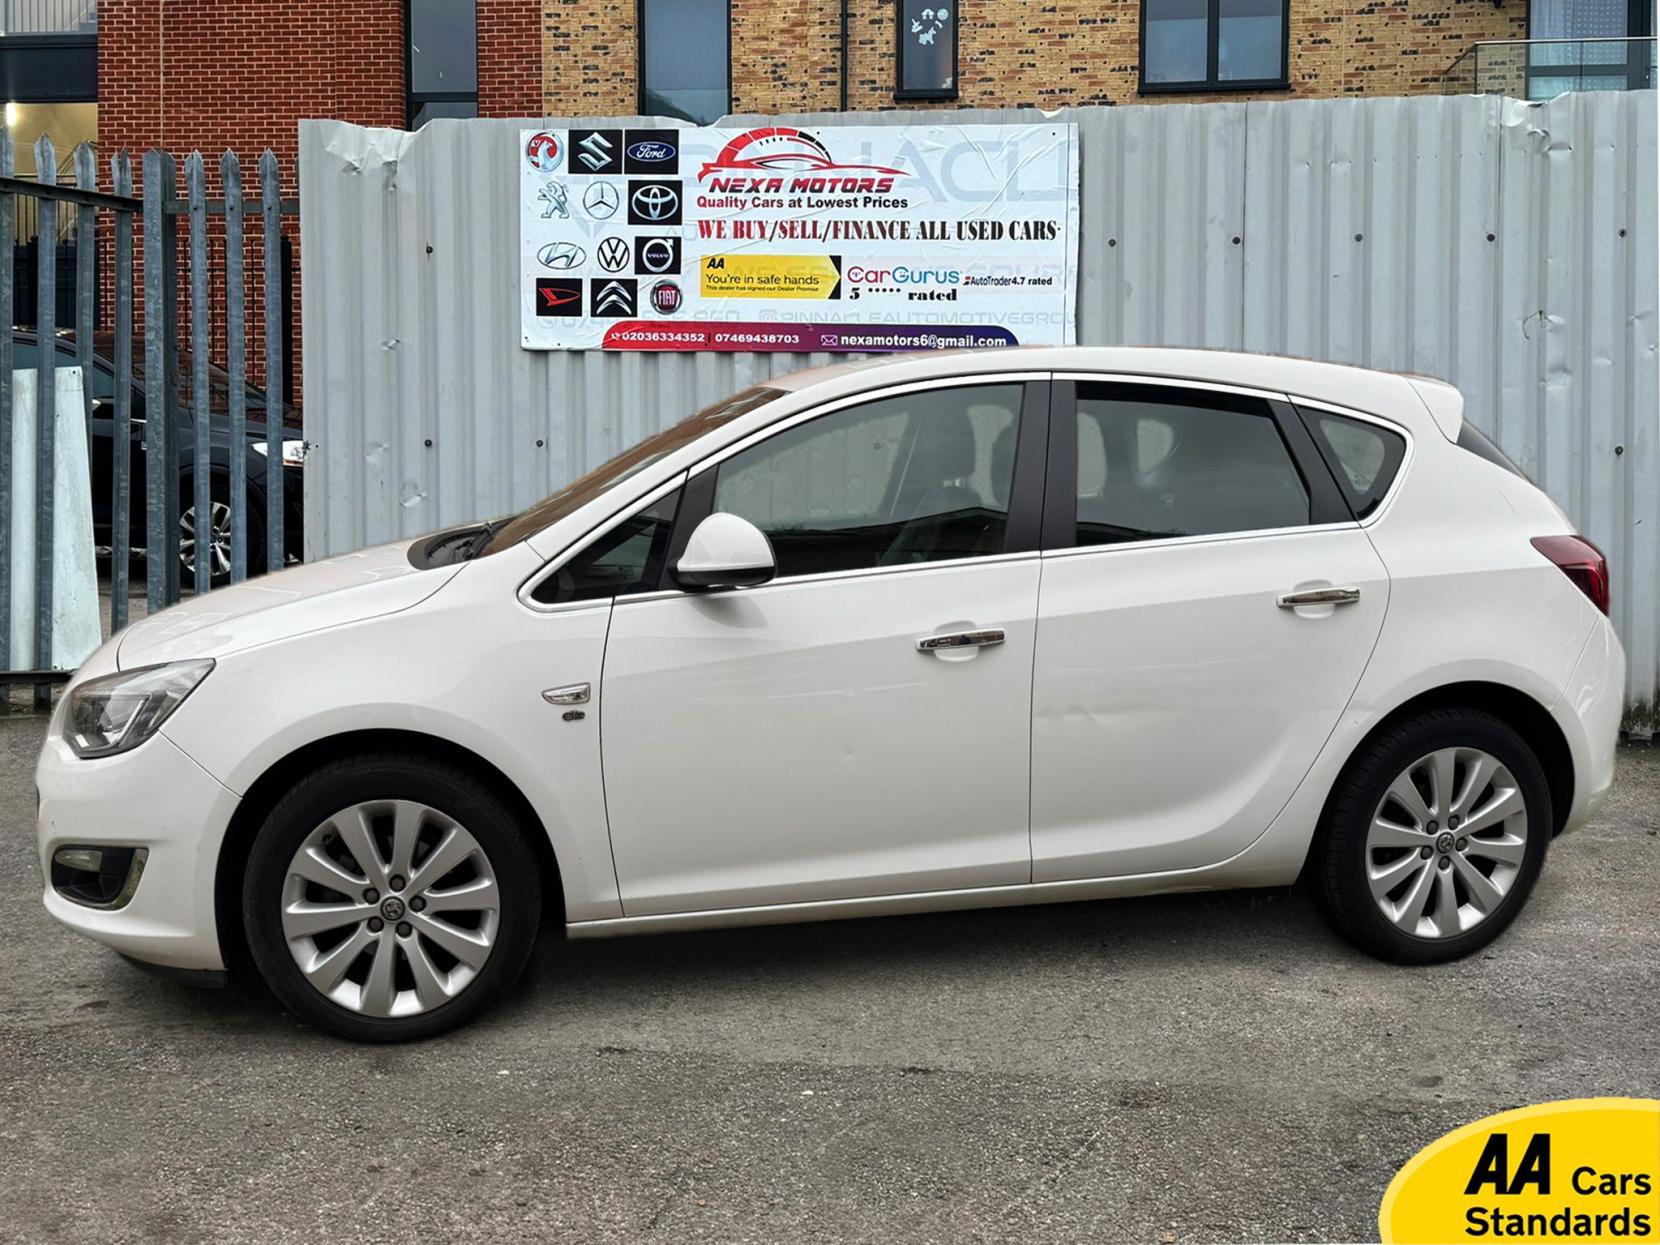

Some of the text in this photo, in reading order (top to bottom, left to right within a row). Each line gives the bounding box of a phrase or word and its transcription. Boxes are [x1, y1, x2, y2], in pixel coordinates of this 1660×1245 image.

[636, 144, 667, 158] Ford
[709, 178, 895, 194] NEXA MOTORS
[697, 196, 908, 210] Quality Cars at Lowest Prices
[697, 220, 727, 240] WE
[732, 220, 911, 242] BUY/SELL/FINANCE
[916, 220, 950, 240] ALL
[956, 220, 1004, 240] USED
[1009, 220, 1057, 241] CARS
[706, 257, 725, 269] AA
[706, 273, 819, 285] You're in safe hands
[847, 266, 961, 284] CarGurus
[1028, 277, 1053, 286] rated
[747, 285, 765, 293] signed
[849, 287, 958, 301] 5 rated
[657, 290, 677, 306] FIAT
[622, 332, 800, 344] 02036334352 07469438703
[841, 334, 1007, 349] nexamotors6@gmail.com
